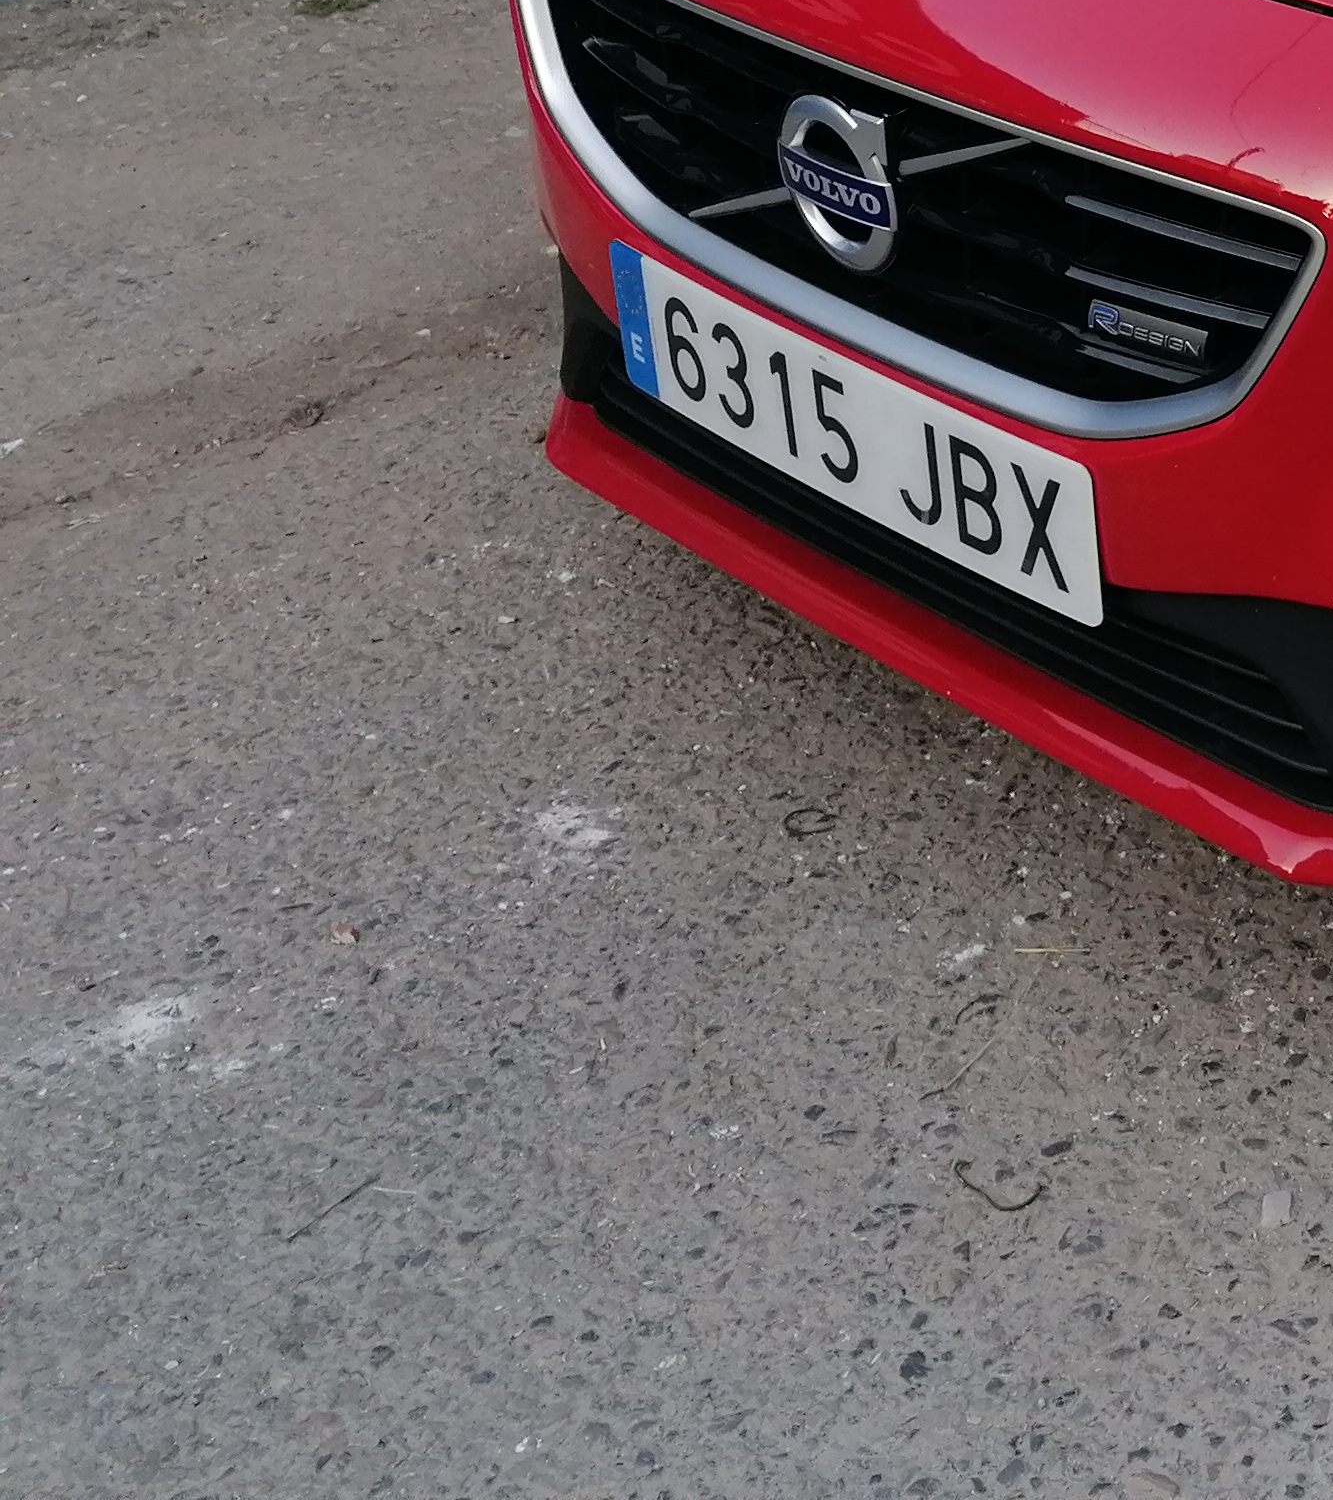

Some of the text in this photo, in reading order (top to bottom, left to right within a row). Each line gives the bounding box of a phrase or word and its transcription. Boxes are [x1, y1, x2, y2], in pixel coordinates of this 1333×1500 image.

[783, 154, 882, 217] VOLVO
[662, 296, 860, 485] 6315
[899, 421, 1070, 595] JBX
